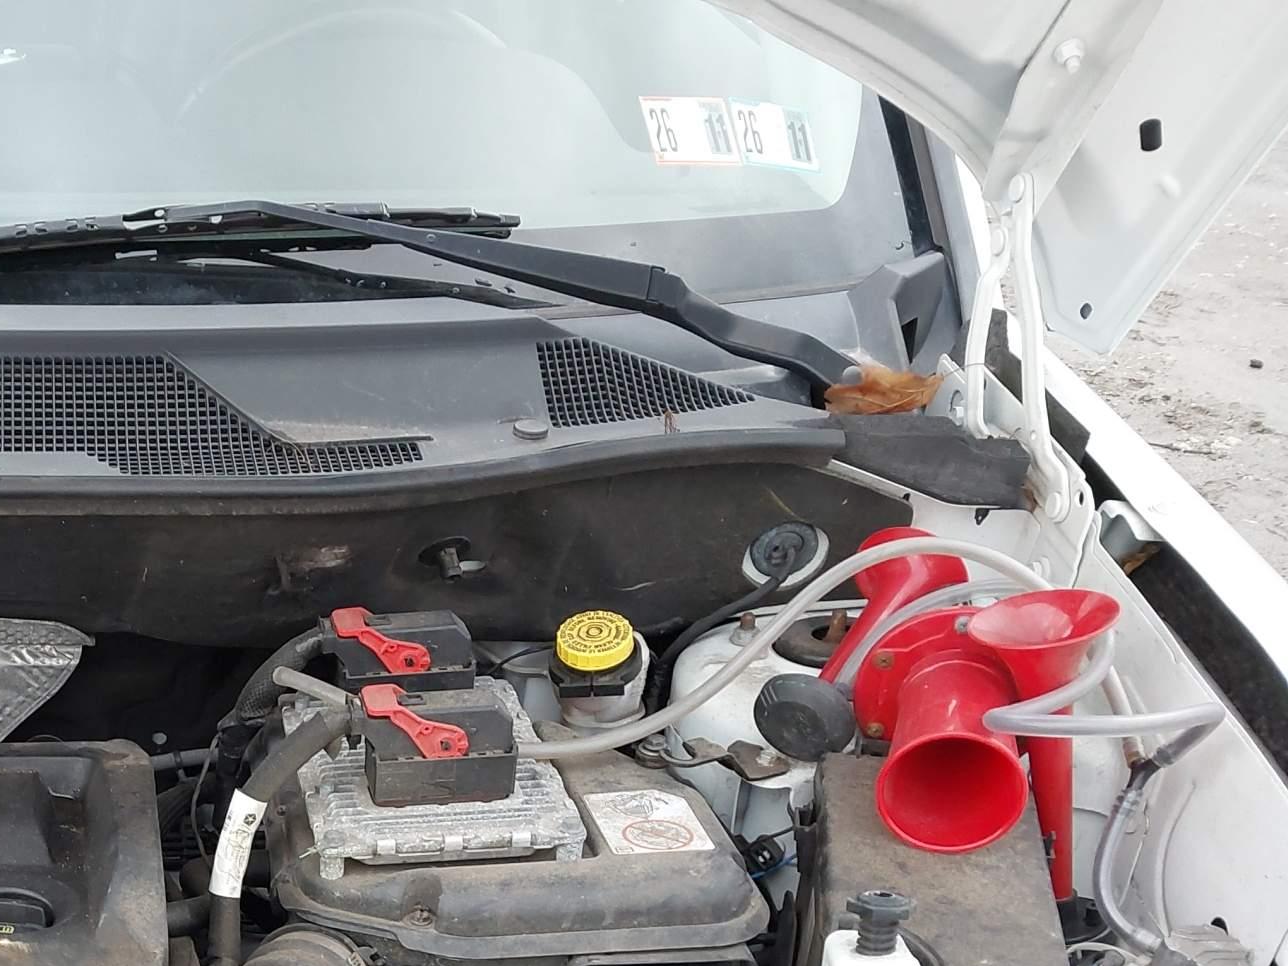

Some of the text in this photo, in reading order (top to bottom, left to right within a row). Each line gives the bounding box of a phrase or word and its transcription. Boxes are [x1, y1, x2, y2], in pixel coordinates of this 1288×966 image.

[649, 107, 732, 153] 26 11
[737, 109, 812, 162] 26 11
